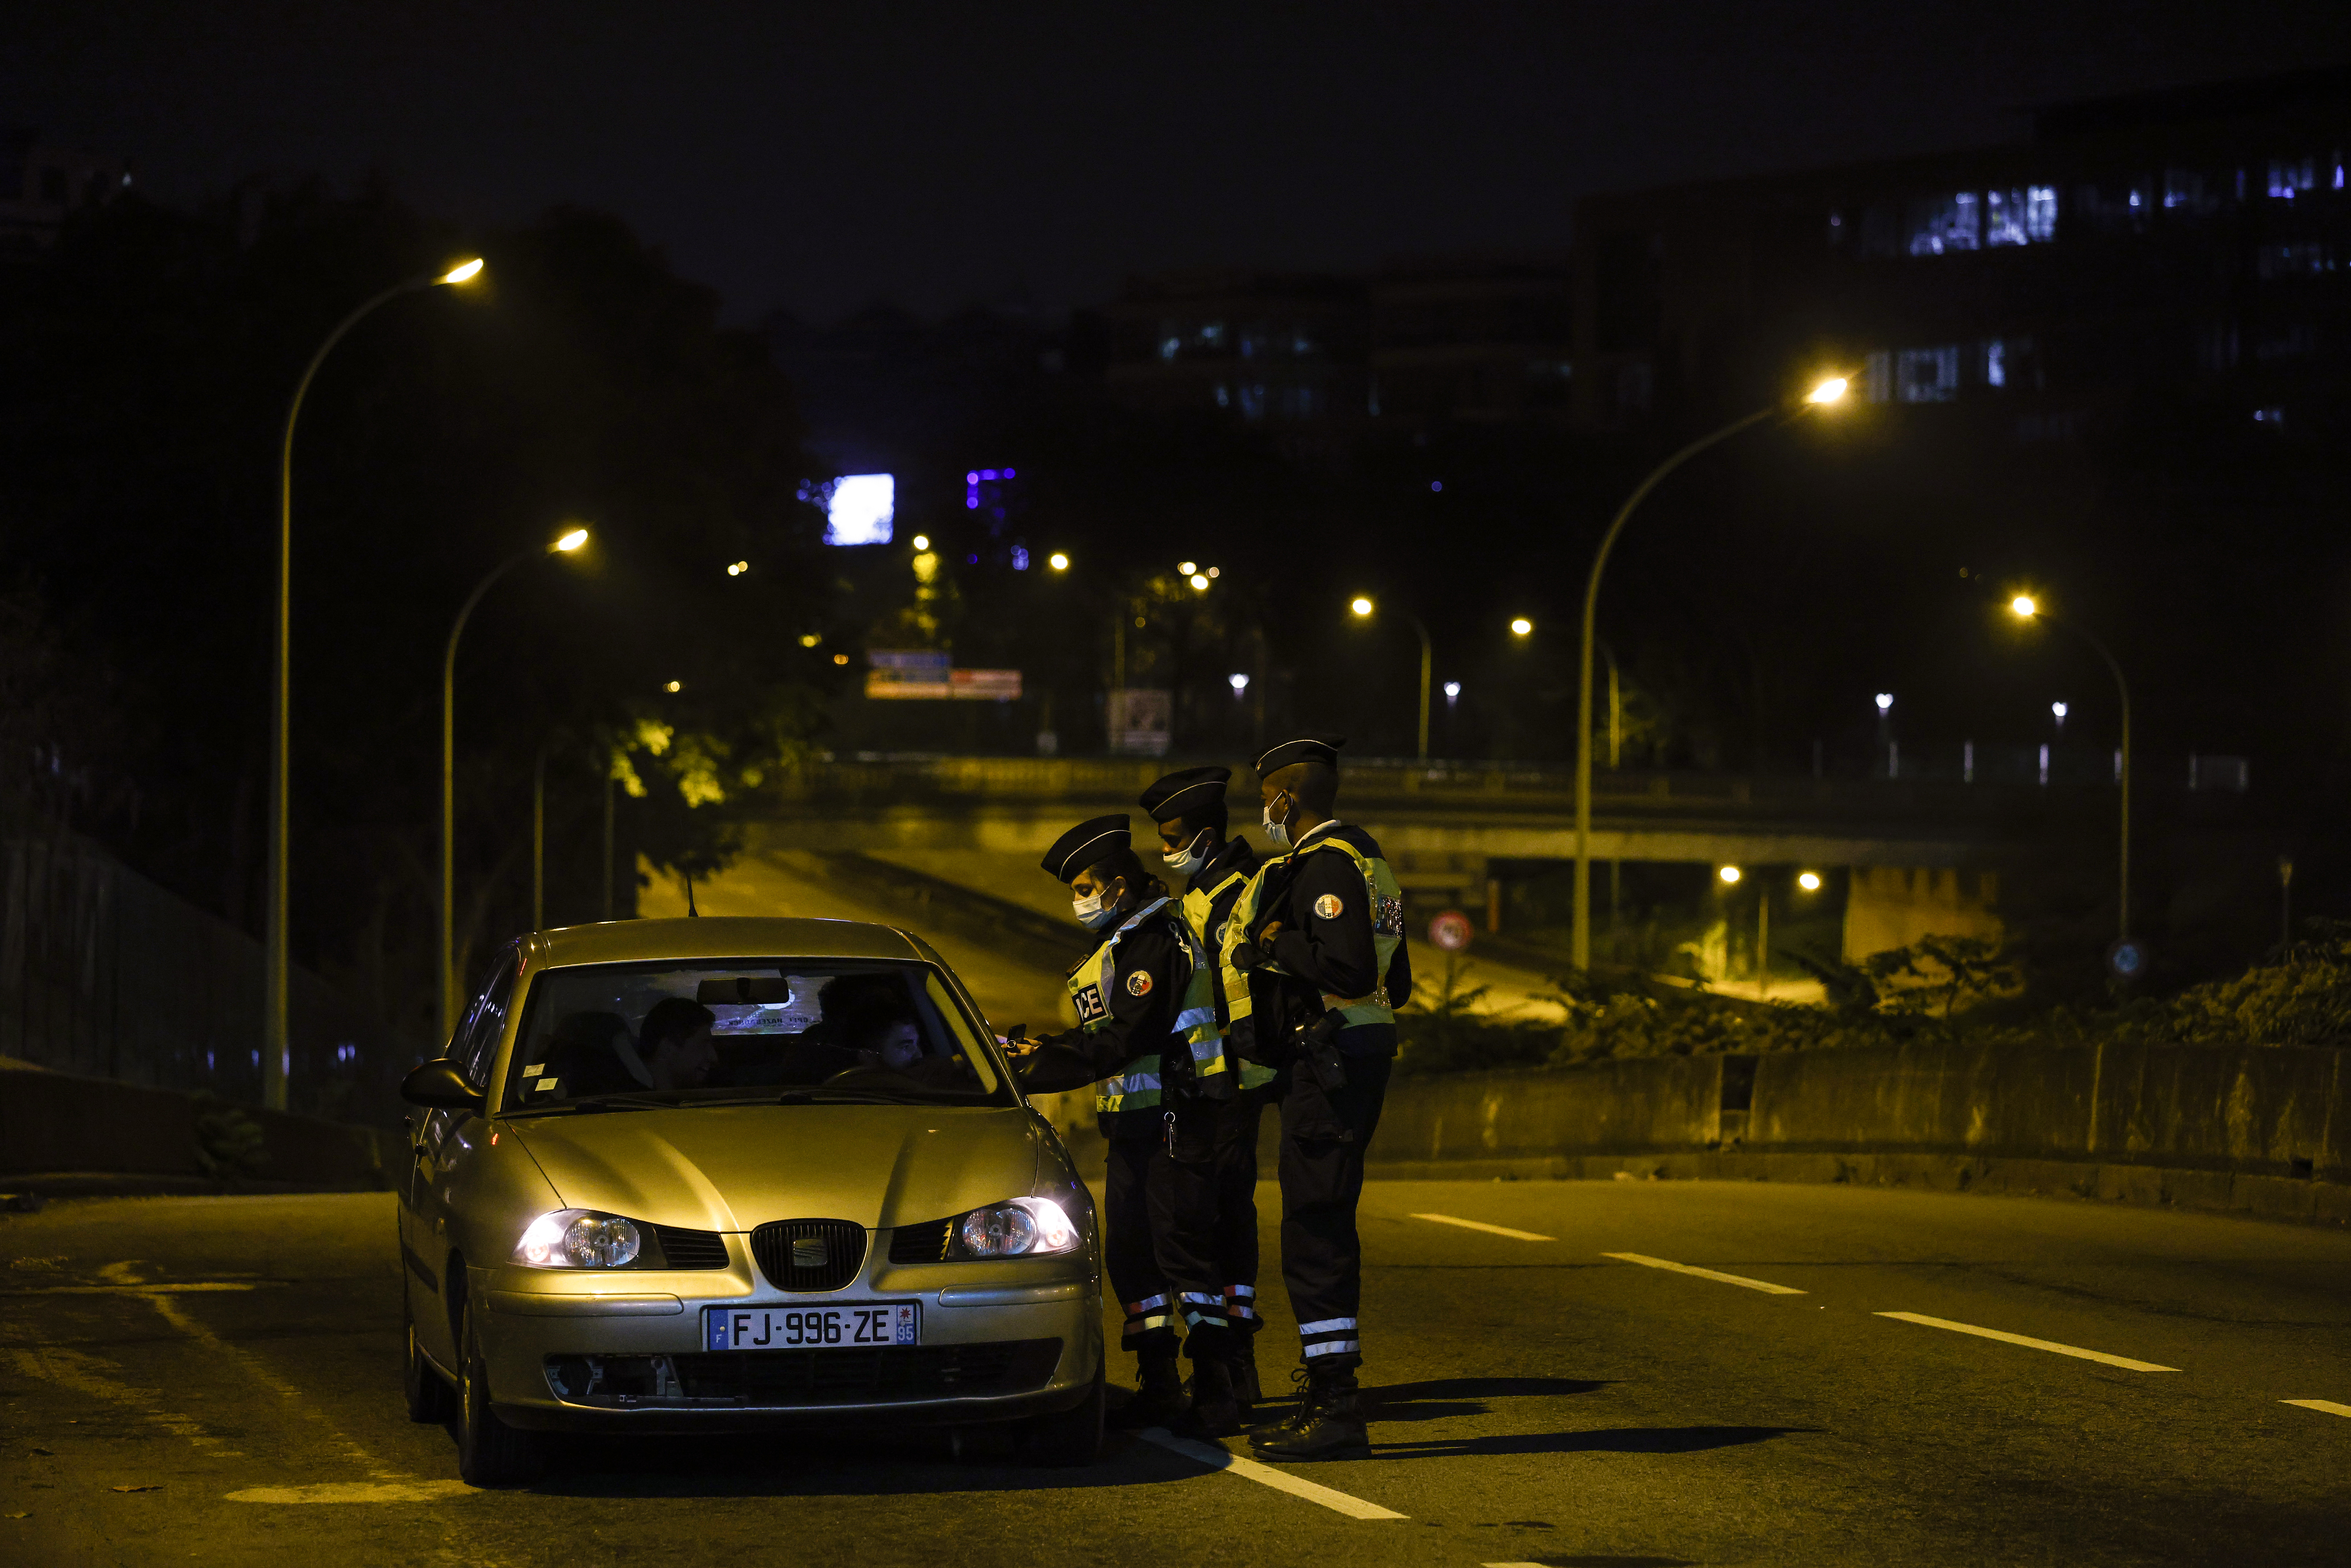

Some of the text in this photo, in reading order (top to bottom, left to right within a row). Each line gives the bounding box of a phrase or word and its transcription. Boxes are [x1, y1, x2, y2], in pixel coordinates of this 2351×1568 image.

[734, 1310, 889, 1346] FJ-996-ZE
[897, 1326, 913, 1341] 95
[716, 1334, 722, 1343] F
